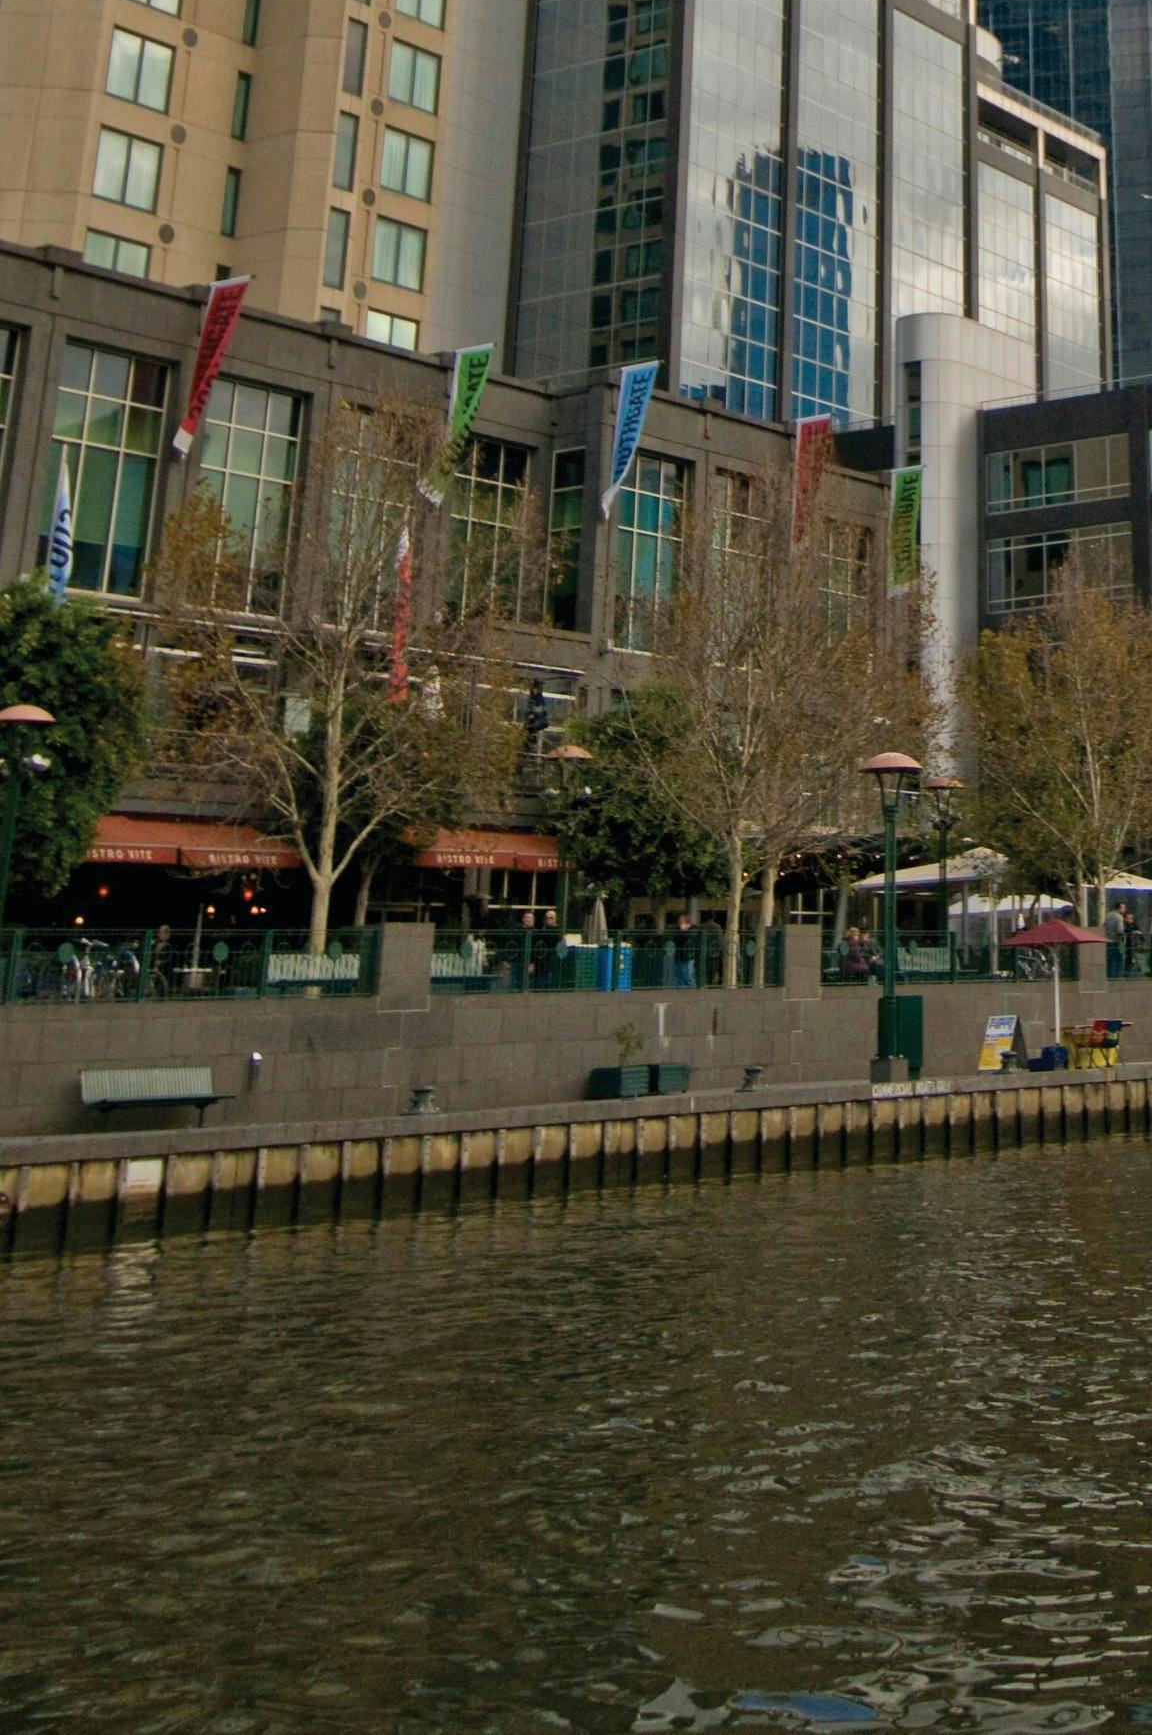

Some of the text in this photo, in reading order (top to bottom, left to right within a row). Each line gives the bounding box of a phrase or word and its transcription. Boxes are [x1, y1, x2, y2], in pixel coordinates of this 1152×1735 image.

[128, 849, 153, 860] VITE
[208, 853, 250, 864] BISTRO
[436, 853, 472, 865] BISTRO
